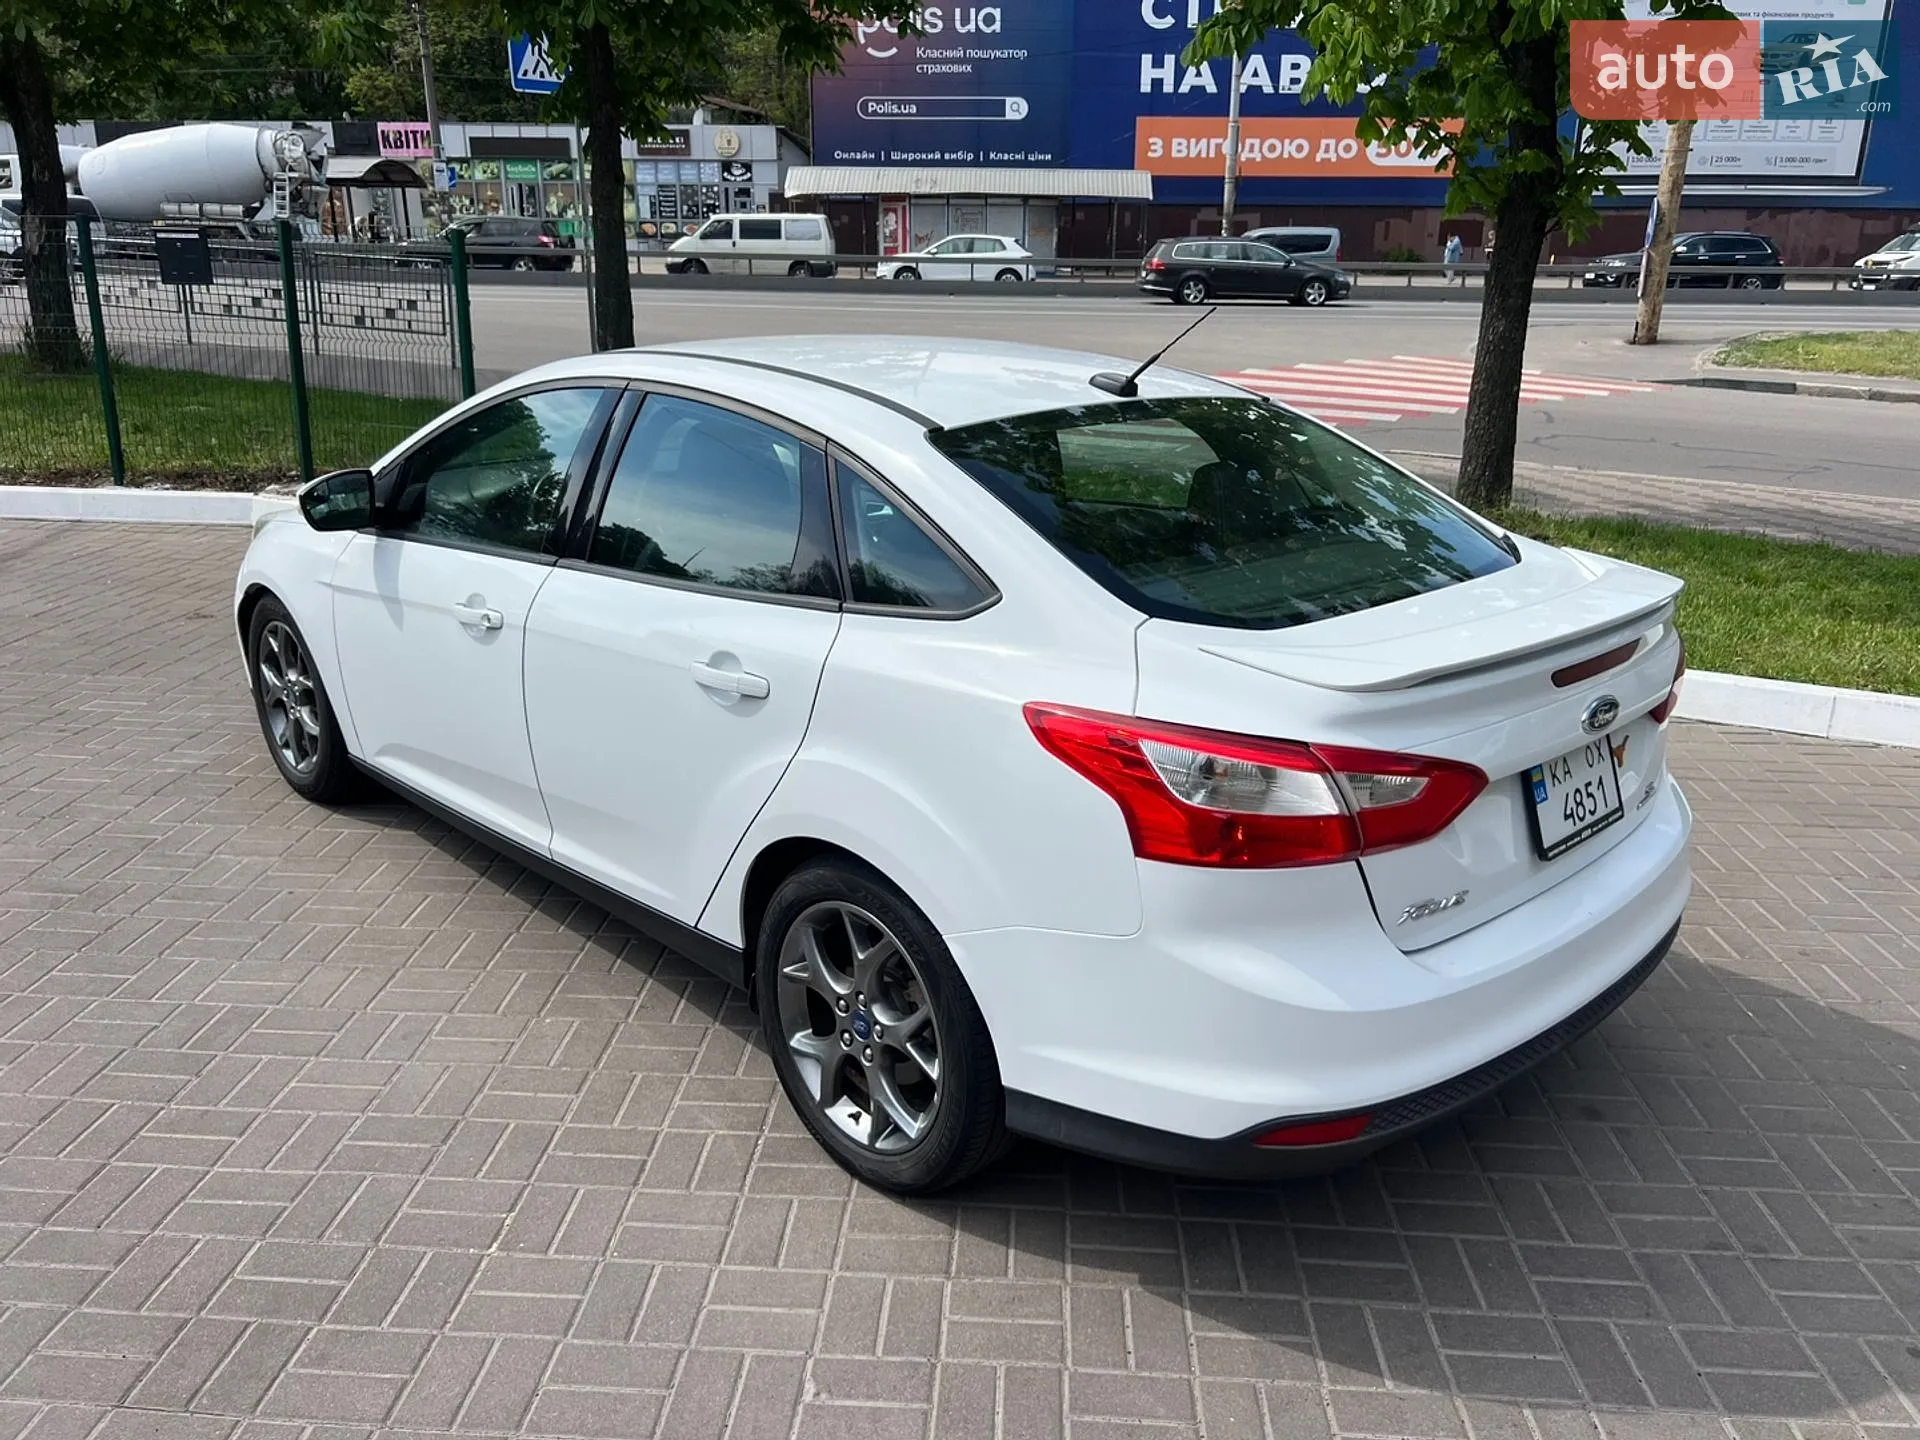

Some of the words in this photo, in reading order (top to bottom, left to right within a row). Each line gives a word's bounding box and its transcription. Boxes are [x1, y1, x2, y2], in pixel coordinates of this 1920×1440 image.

[955, 7, 1001, 33] ua
[916, 47, 963, 59] Класний
[967, 49, 1027, 60] пошукатор
[916, 64, 972, 74] страхових
[1140, 54, 1218, 94] НА
[868, 102, 917, 114] Polis.ua
[381, 129, 432, 149] КВІТИ
[834, 150, 876, 160] Онлайн
[890, 150, 941, 162] Широкий
[944, 150, 974, 162] вибір
[989, 151, 1025, 161] Класні
[1027, 152, 1052, 162] ціни
[1171, 138, 1310, 162] ВИГДОЮ
[1316, 138, 1358, 162] ДО
[1563, 774, 1608, 827] 4851
